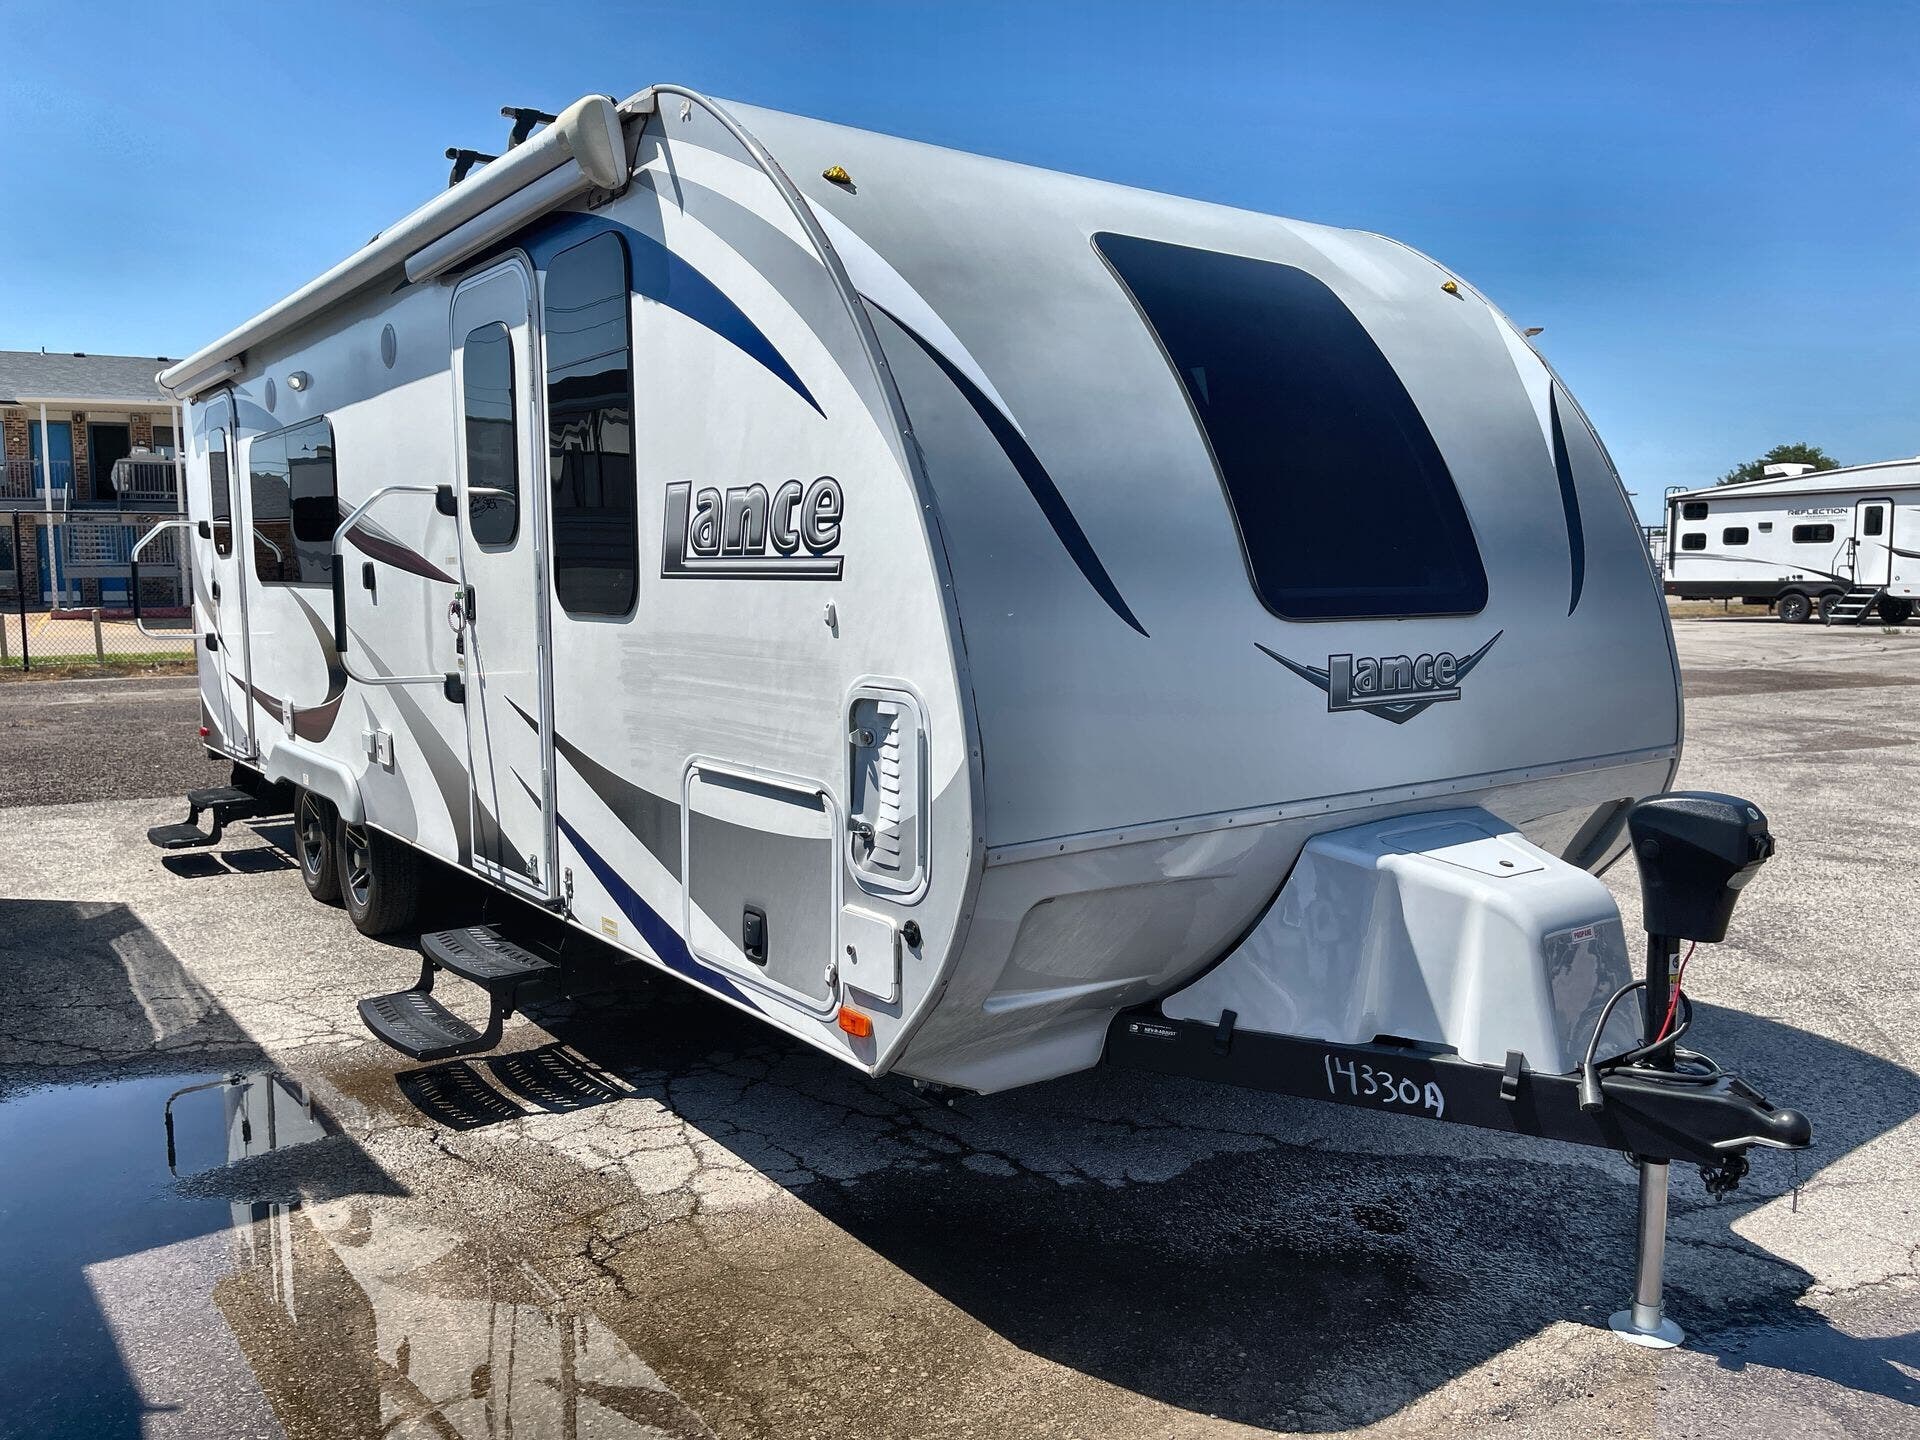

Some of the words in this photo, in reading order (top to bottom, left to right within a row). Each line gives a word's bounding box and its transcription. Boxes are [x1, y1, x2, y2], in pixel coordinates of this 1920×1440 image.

[660, 475, 845, 581] Lance
[1787, 508, 1848, 516] REFLECTION
[1327, 652, 1461, 713] Lance
[1324, 1054, 1446, 1118] 14330A
